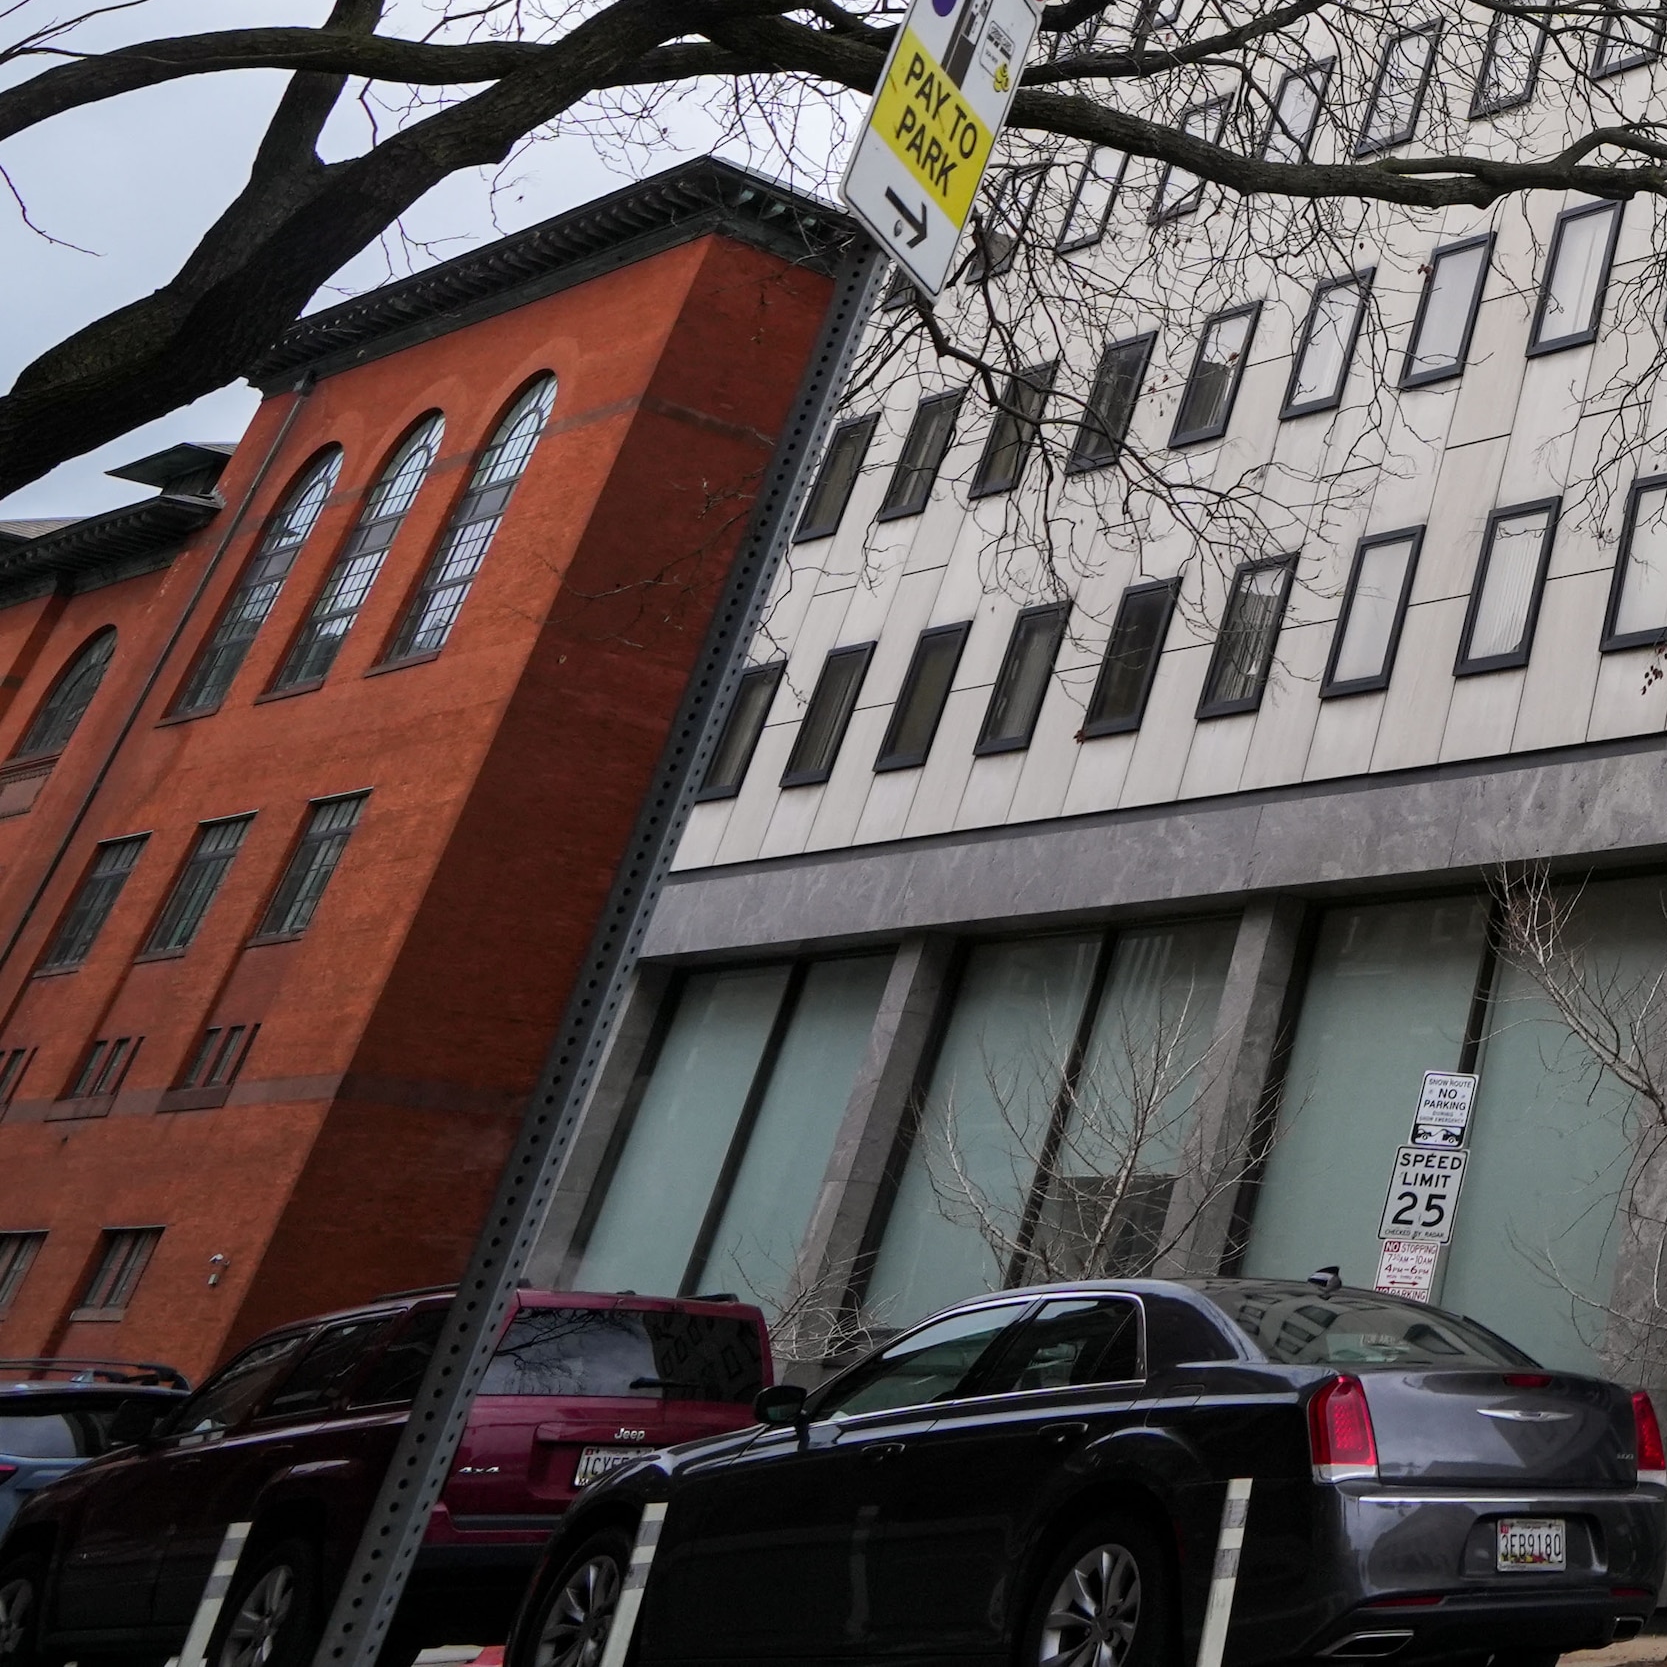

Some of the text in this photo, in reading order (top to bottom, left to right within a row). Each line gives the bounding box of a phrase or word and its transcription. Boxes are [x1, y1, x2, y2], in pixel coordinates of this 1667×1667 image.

[905, 52, 977, 159] PAY TO
[896, 105, 957, 198] PARK
[1429, 1078, 1472, 1088] SNOW ROUTE
[1438, 1088, 1458, 1099] NO
[1423, 1099, 1466, 1111] PARKING
[1400, 1153, 1462, 1170] SPEED
[1402, 1172, 1451, 1188] LIMIT
[1391, 1191, 1446, 1227] 25
[1385, 1242, 1437, 1254] NO STOPPING
[614, 1427, 645, 1441] Jeep
[1501, 1533, 1561, 1558] 3EB9180
